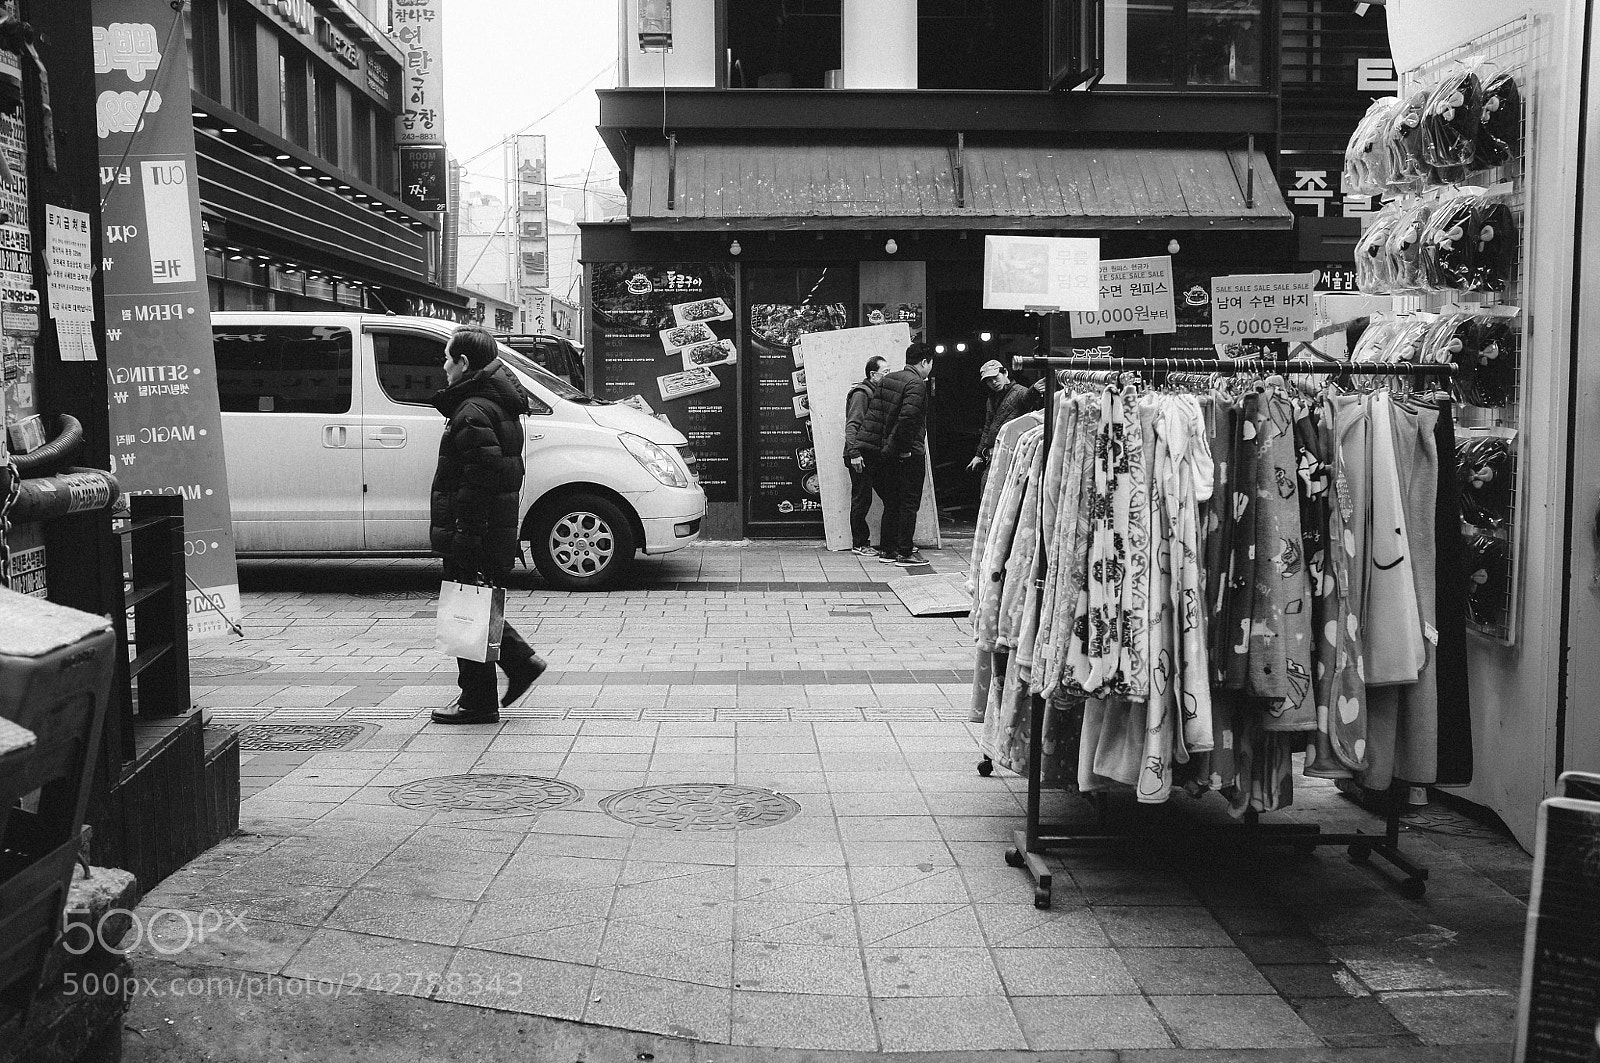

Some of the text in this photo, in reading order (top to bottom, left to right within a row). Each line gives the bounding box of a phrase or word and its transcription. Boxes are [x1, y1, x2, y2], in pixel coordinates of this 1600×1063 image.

[394, 9, 436, 22] 참나무
[403, 109, 436, 130] 곱창
[401, 133, 437, 141] 243-8831
[408, 151, 436, 161] ROOM
[411, 160, 434, 170] HOF
[436, 203, 446, 212] 2F
[1110, 273, 1127, 281] SALE
[1129, 272, 1146, 280] SALE
[1148, 270, 1165, 278] SALE
[1099, 282, 1168, 298] 수면 원피스
[1273, 283, 1290, 291] SALE
[1292, 282, 1309, 290] SALE
[1216, 293, 1309, 310] 남여 수면 바지
